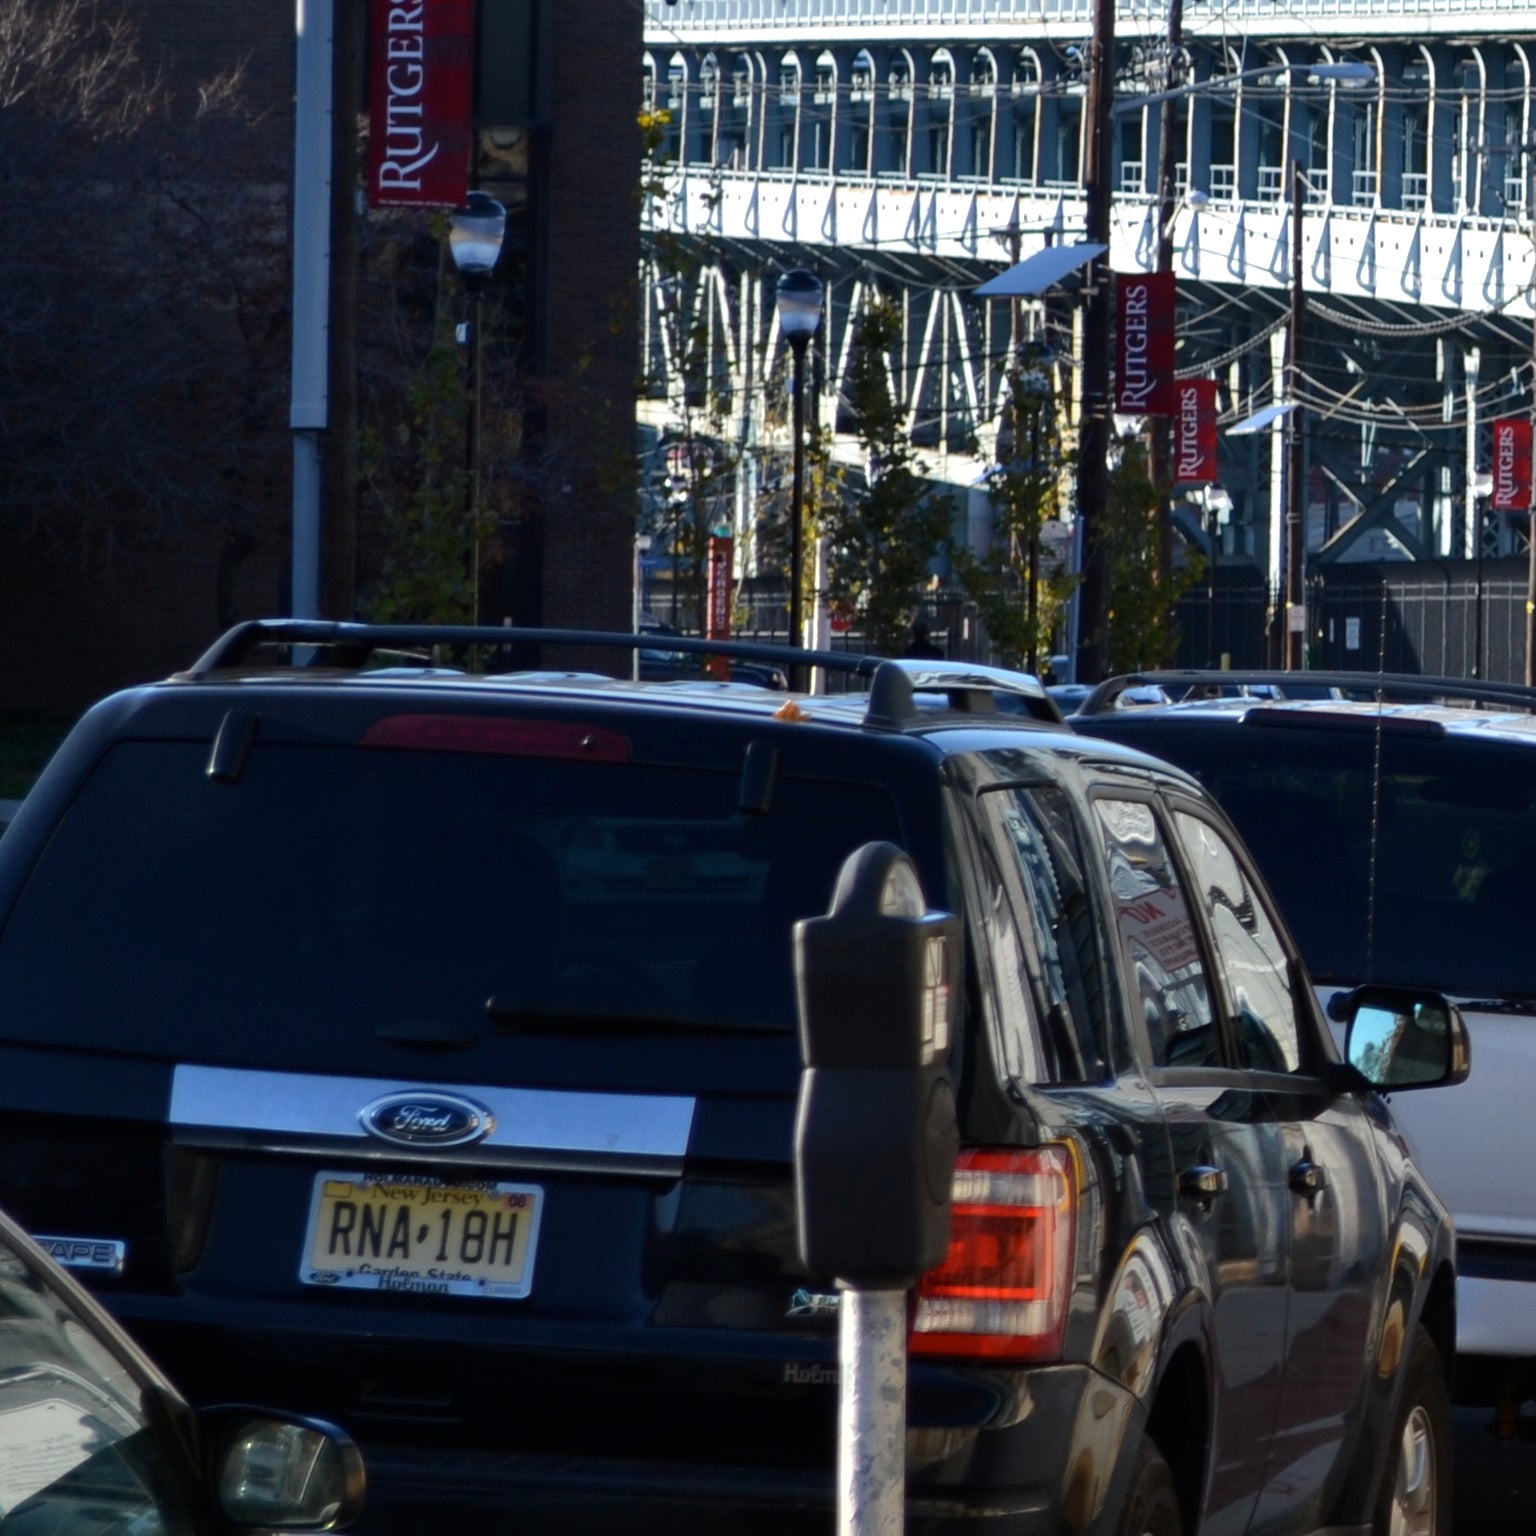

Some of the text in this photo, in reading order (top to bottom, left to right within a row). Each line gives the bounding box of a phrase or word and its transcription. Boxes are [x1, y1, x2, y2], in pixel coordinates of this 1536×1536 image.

[1121, 284, 1157, 408] RUTGERS
[1178, 386, 1205, 478] RUTGERS
[1495, 425, 1519, 506] RUTGERS
[394, 1104, 451, 1132] Ford
[371, 1182, 484, 1206] New Jersey
[783, 1364, 840, 1383] Holm
